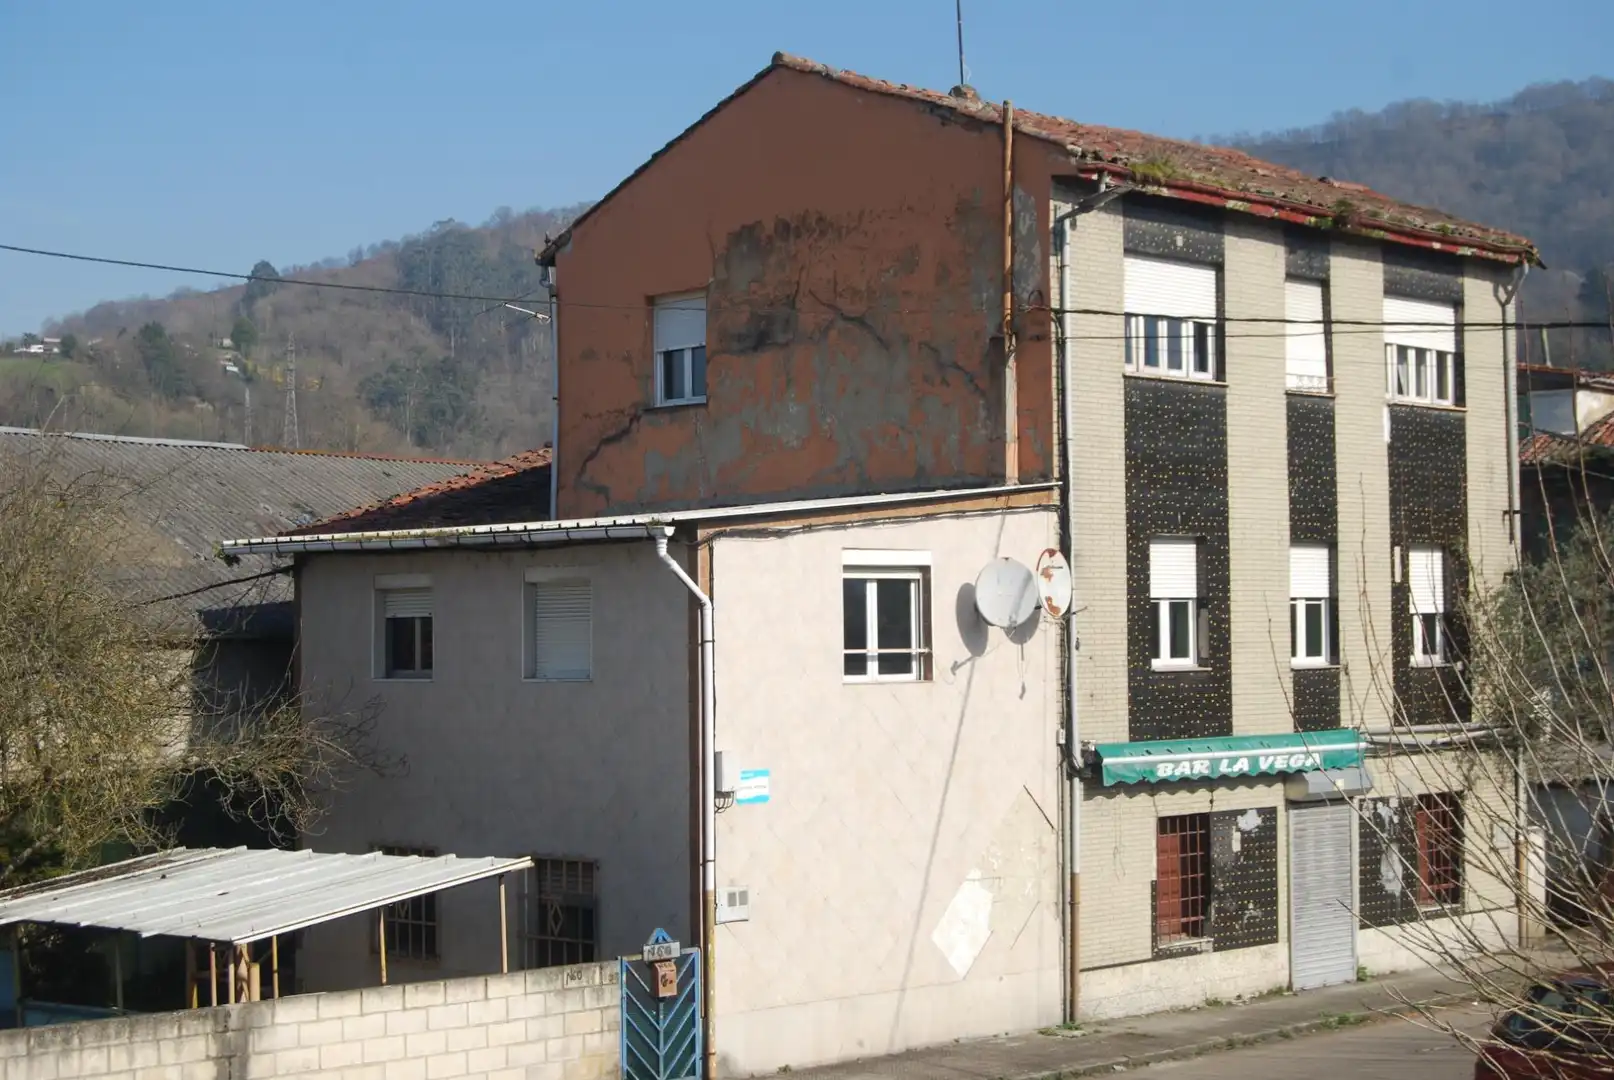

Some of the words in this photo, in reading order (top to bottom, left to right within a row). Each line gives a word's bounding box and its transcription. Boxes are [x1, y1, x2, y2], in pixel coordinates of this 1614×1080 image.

[1156, 759, 1210, 777] BAR
[1219, 757, 1249, 773] LA
[1258, 752, 1321, 770] VEGA
